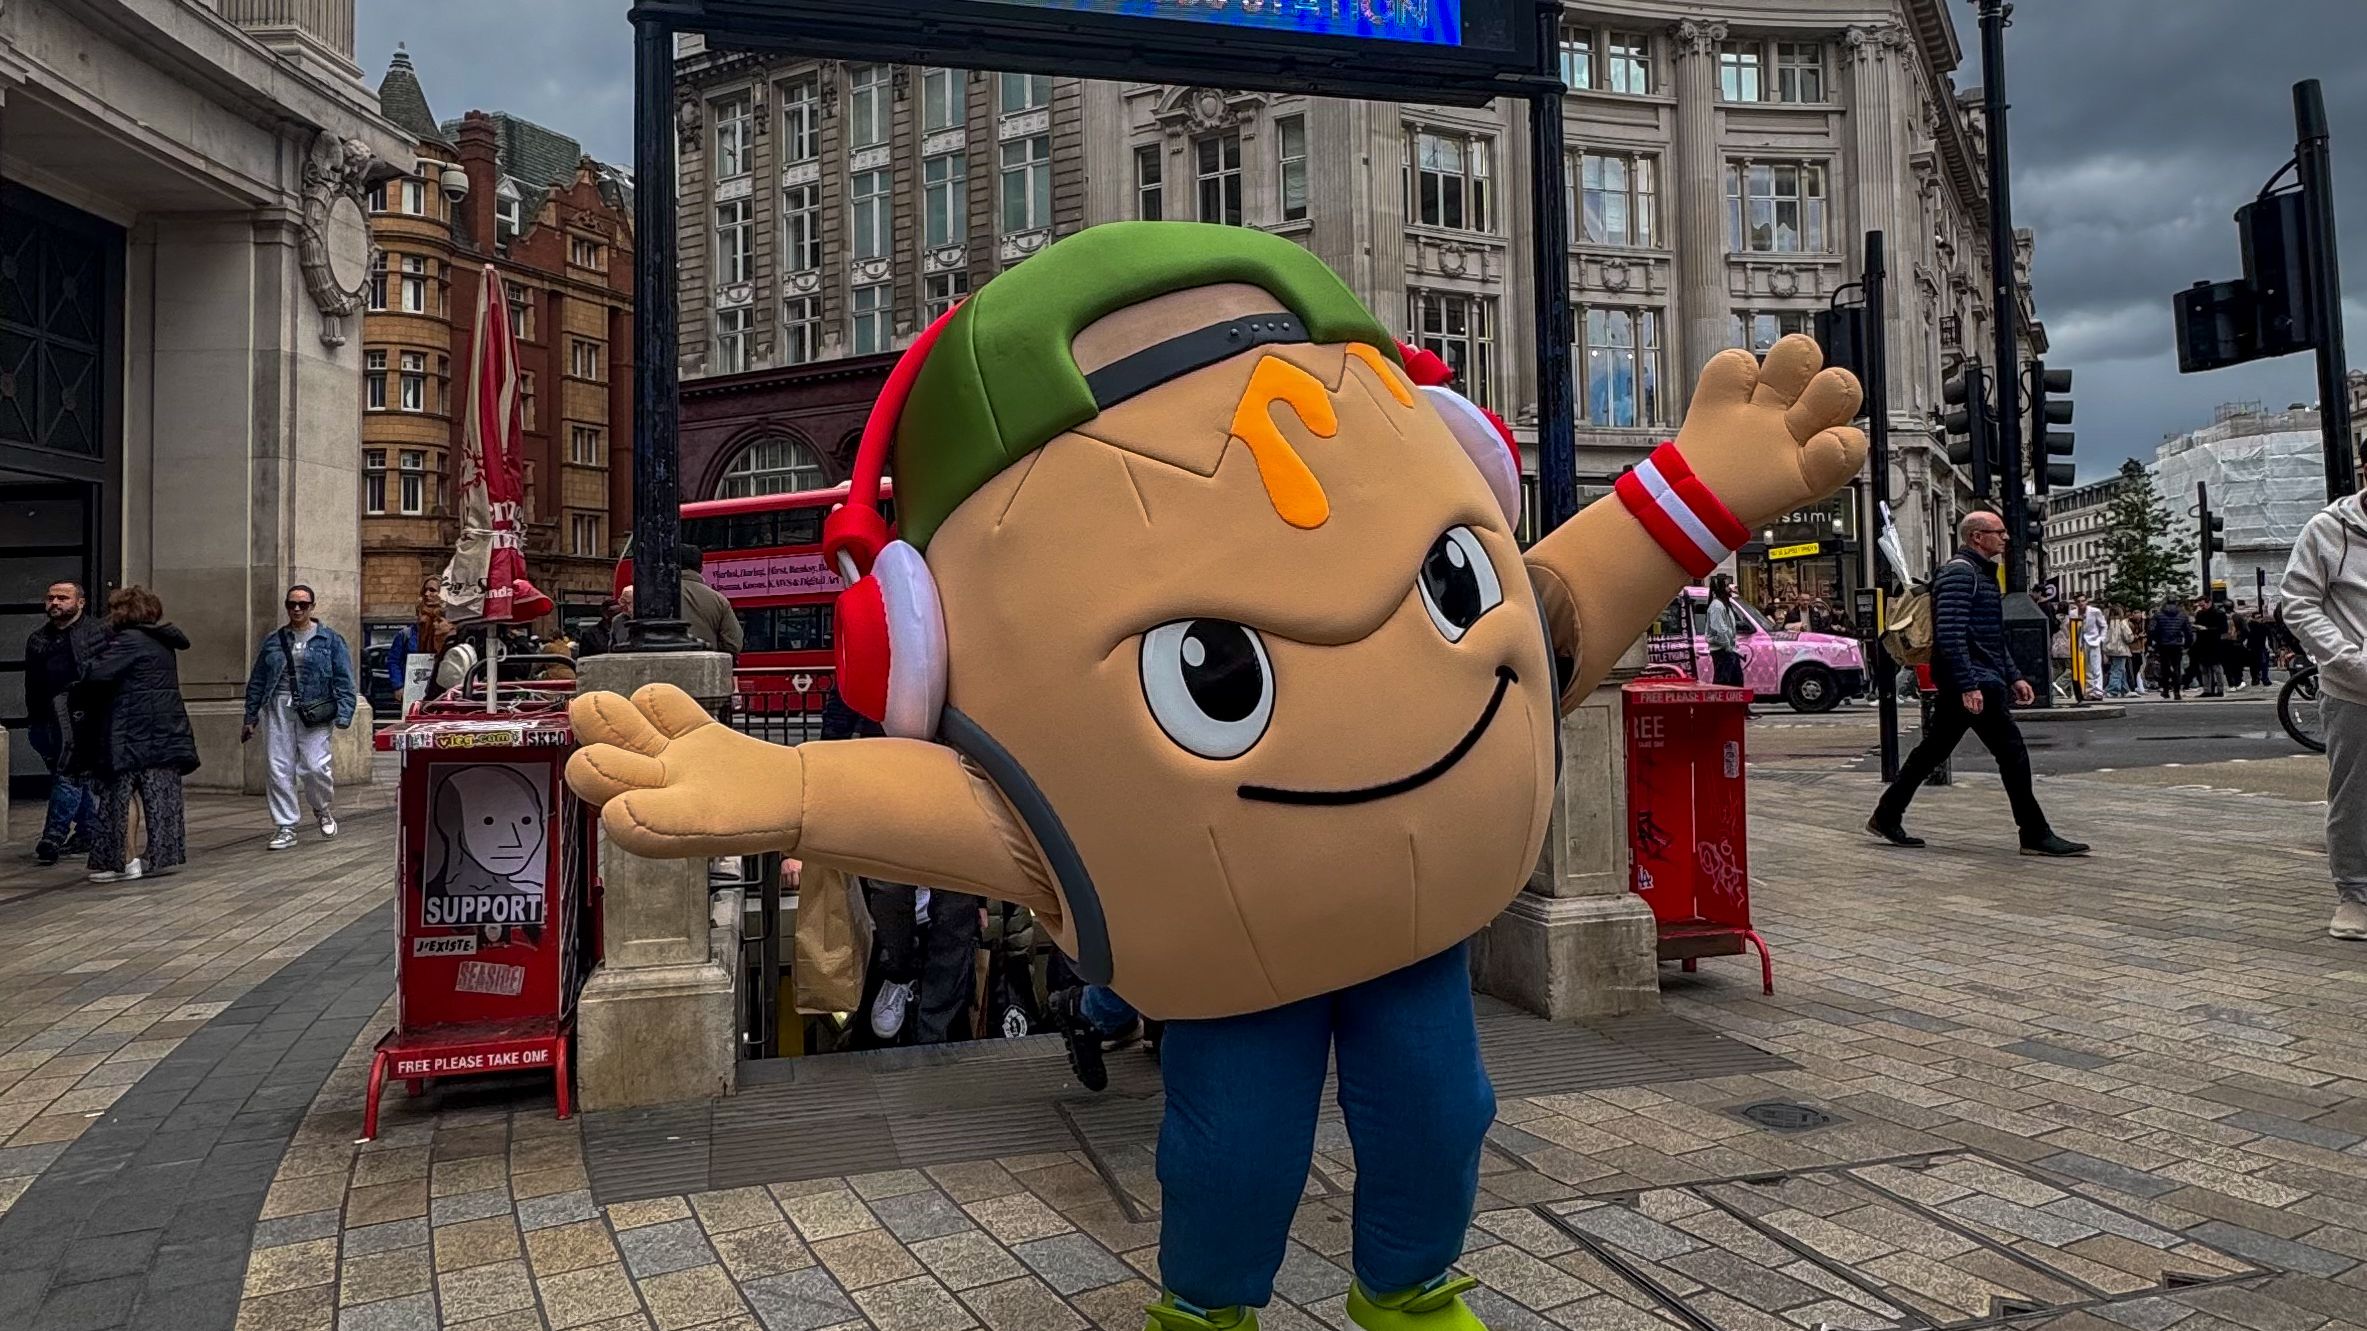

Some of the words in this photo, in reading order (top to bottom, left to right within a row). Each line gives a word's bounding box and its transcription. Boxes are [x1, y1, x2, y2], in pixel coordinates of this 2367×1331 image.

[426, 895, 541, 924] SUPPORT
[398, 1060, 431, 1074] FREE
[434, 1055, 484, 1071] PLEASE
[487, 1052, 520, 1067] TAKE
